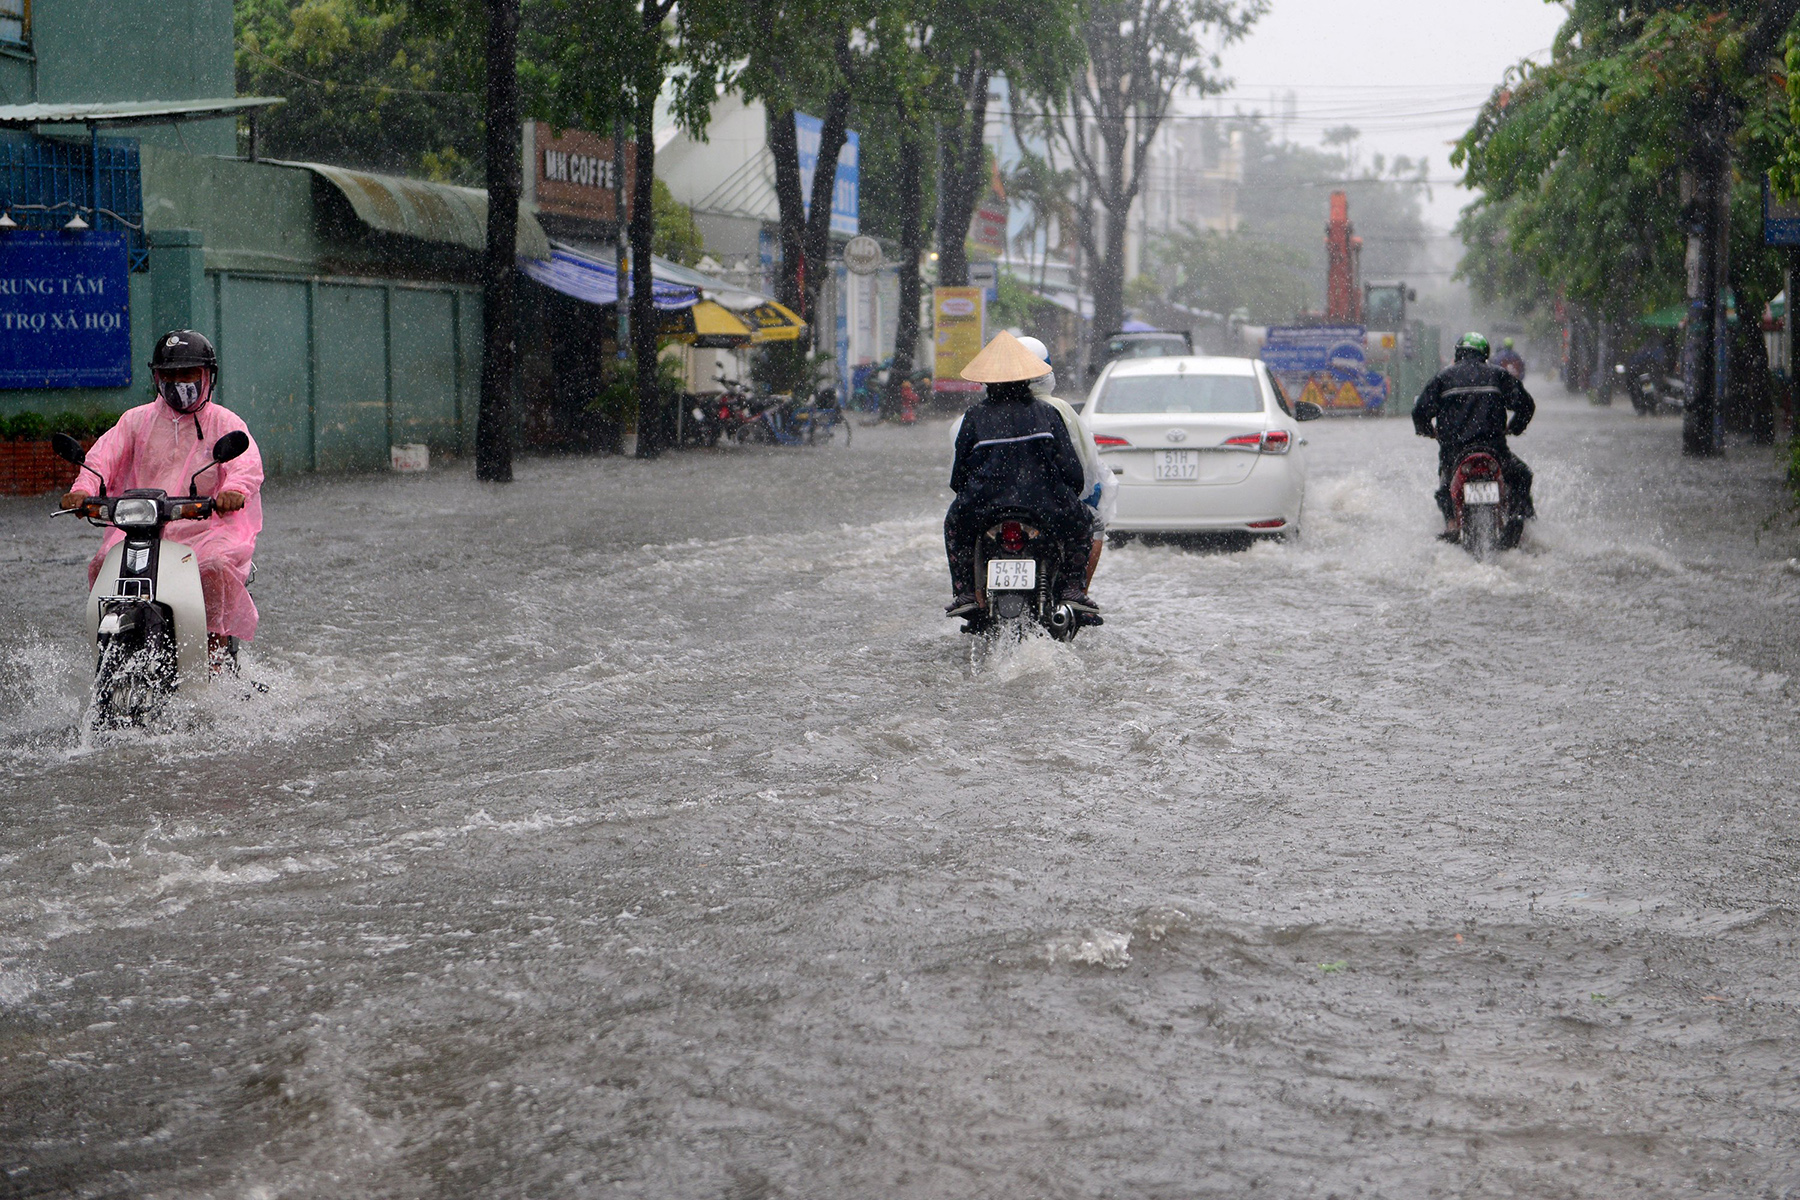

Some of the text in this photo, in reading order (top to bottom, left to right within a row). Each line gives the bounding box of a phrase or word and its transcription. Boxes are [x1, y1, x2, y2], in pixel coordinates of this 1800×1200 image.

[58, 273, 105, 295] TÂM
[3, 309, 121, 333] TRỢ XÃ HỘI
[1165, 451, 1188, 464] 51H
[995, 561, 1028, 574] 54-R4
[995, 575, 1028, 588] 4875
